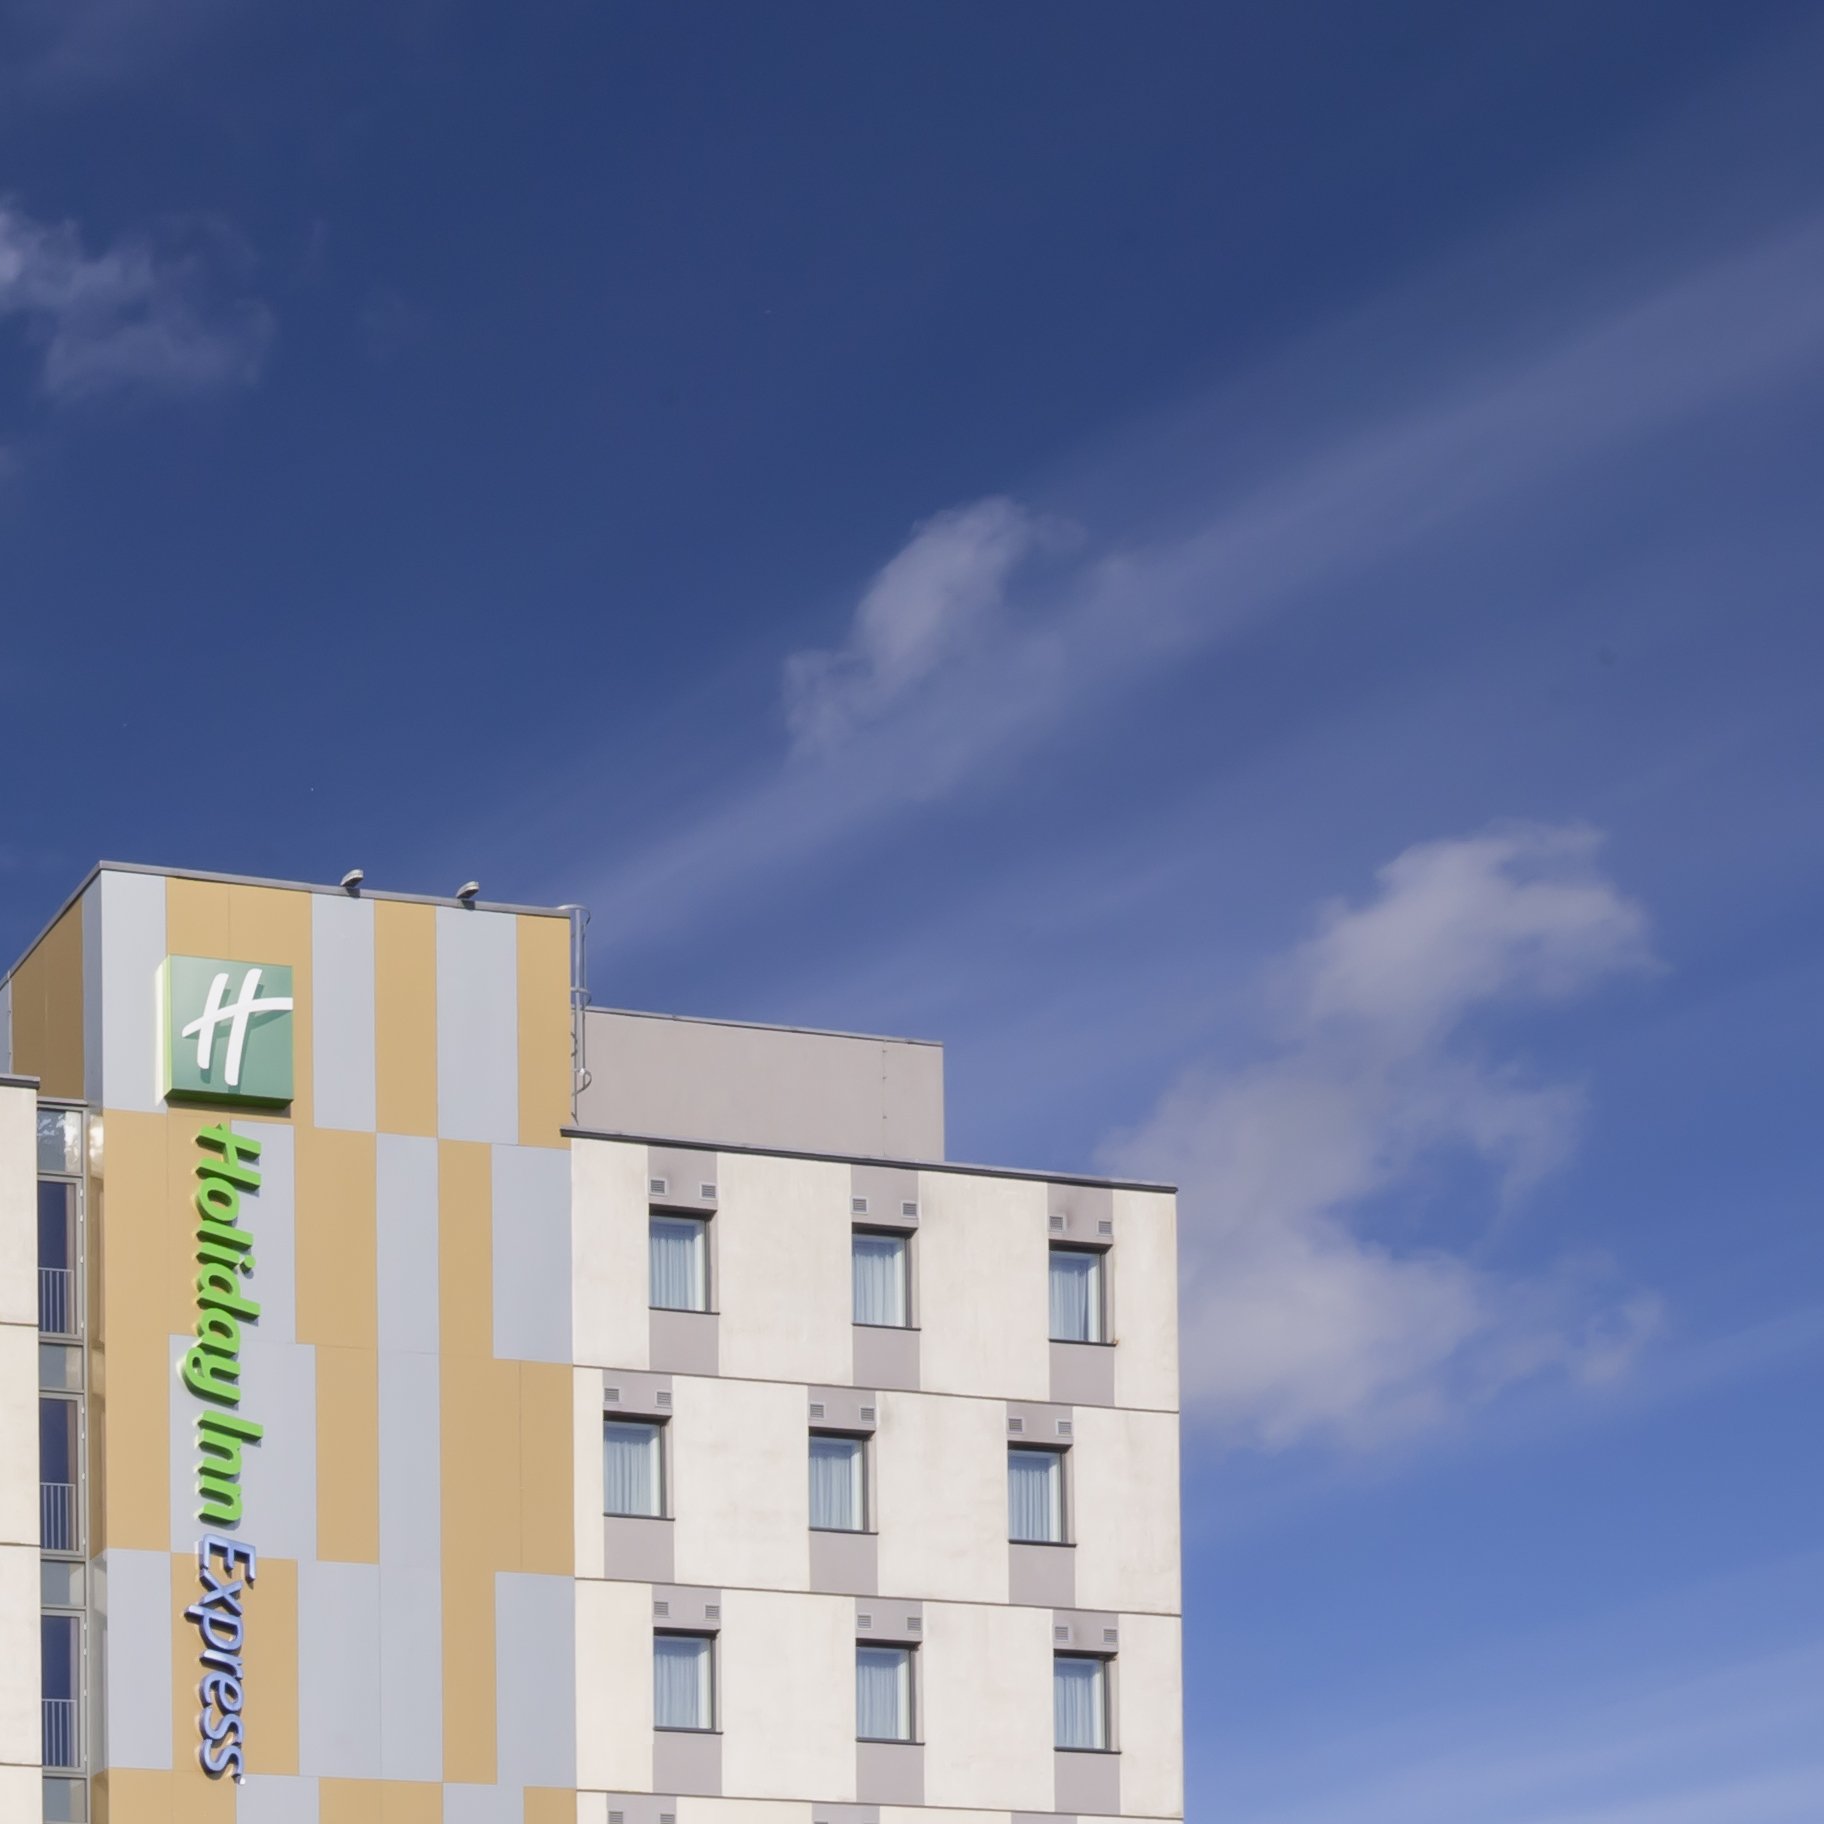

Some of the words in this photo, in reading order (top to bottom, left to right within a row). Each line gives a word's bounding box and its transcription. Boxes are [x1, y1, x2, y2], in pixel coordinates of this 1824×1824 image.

[182, 1123, 262, 1406] Holiday
[197, 1410, 264, 1527] Inn
[184, 1533, 257, 1781] Express
